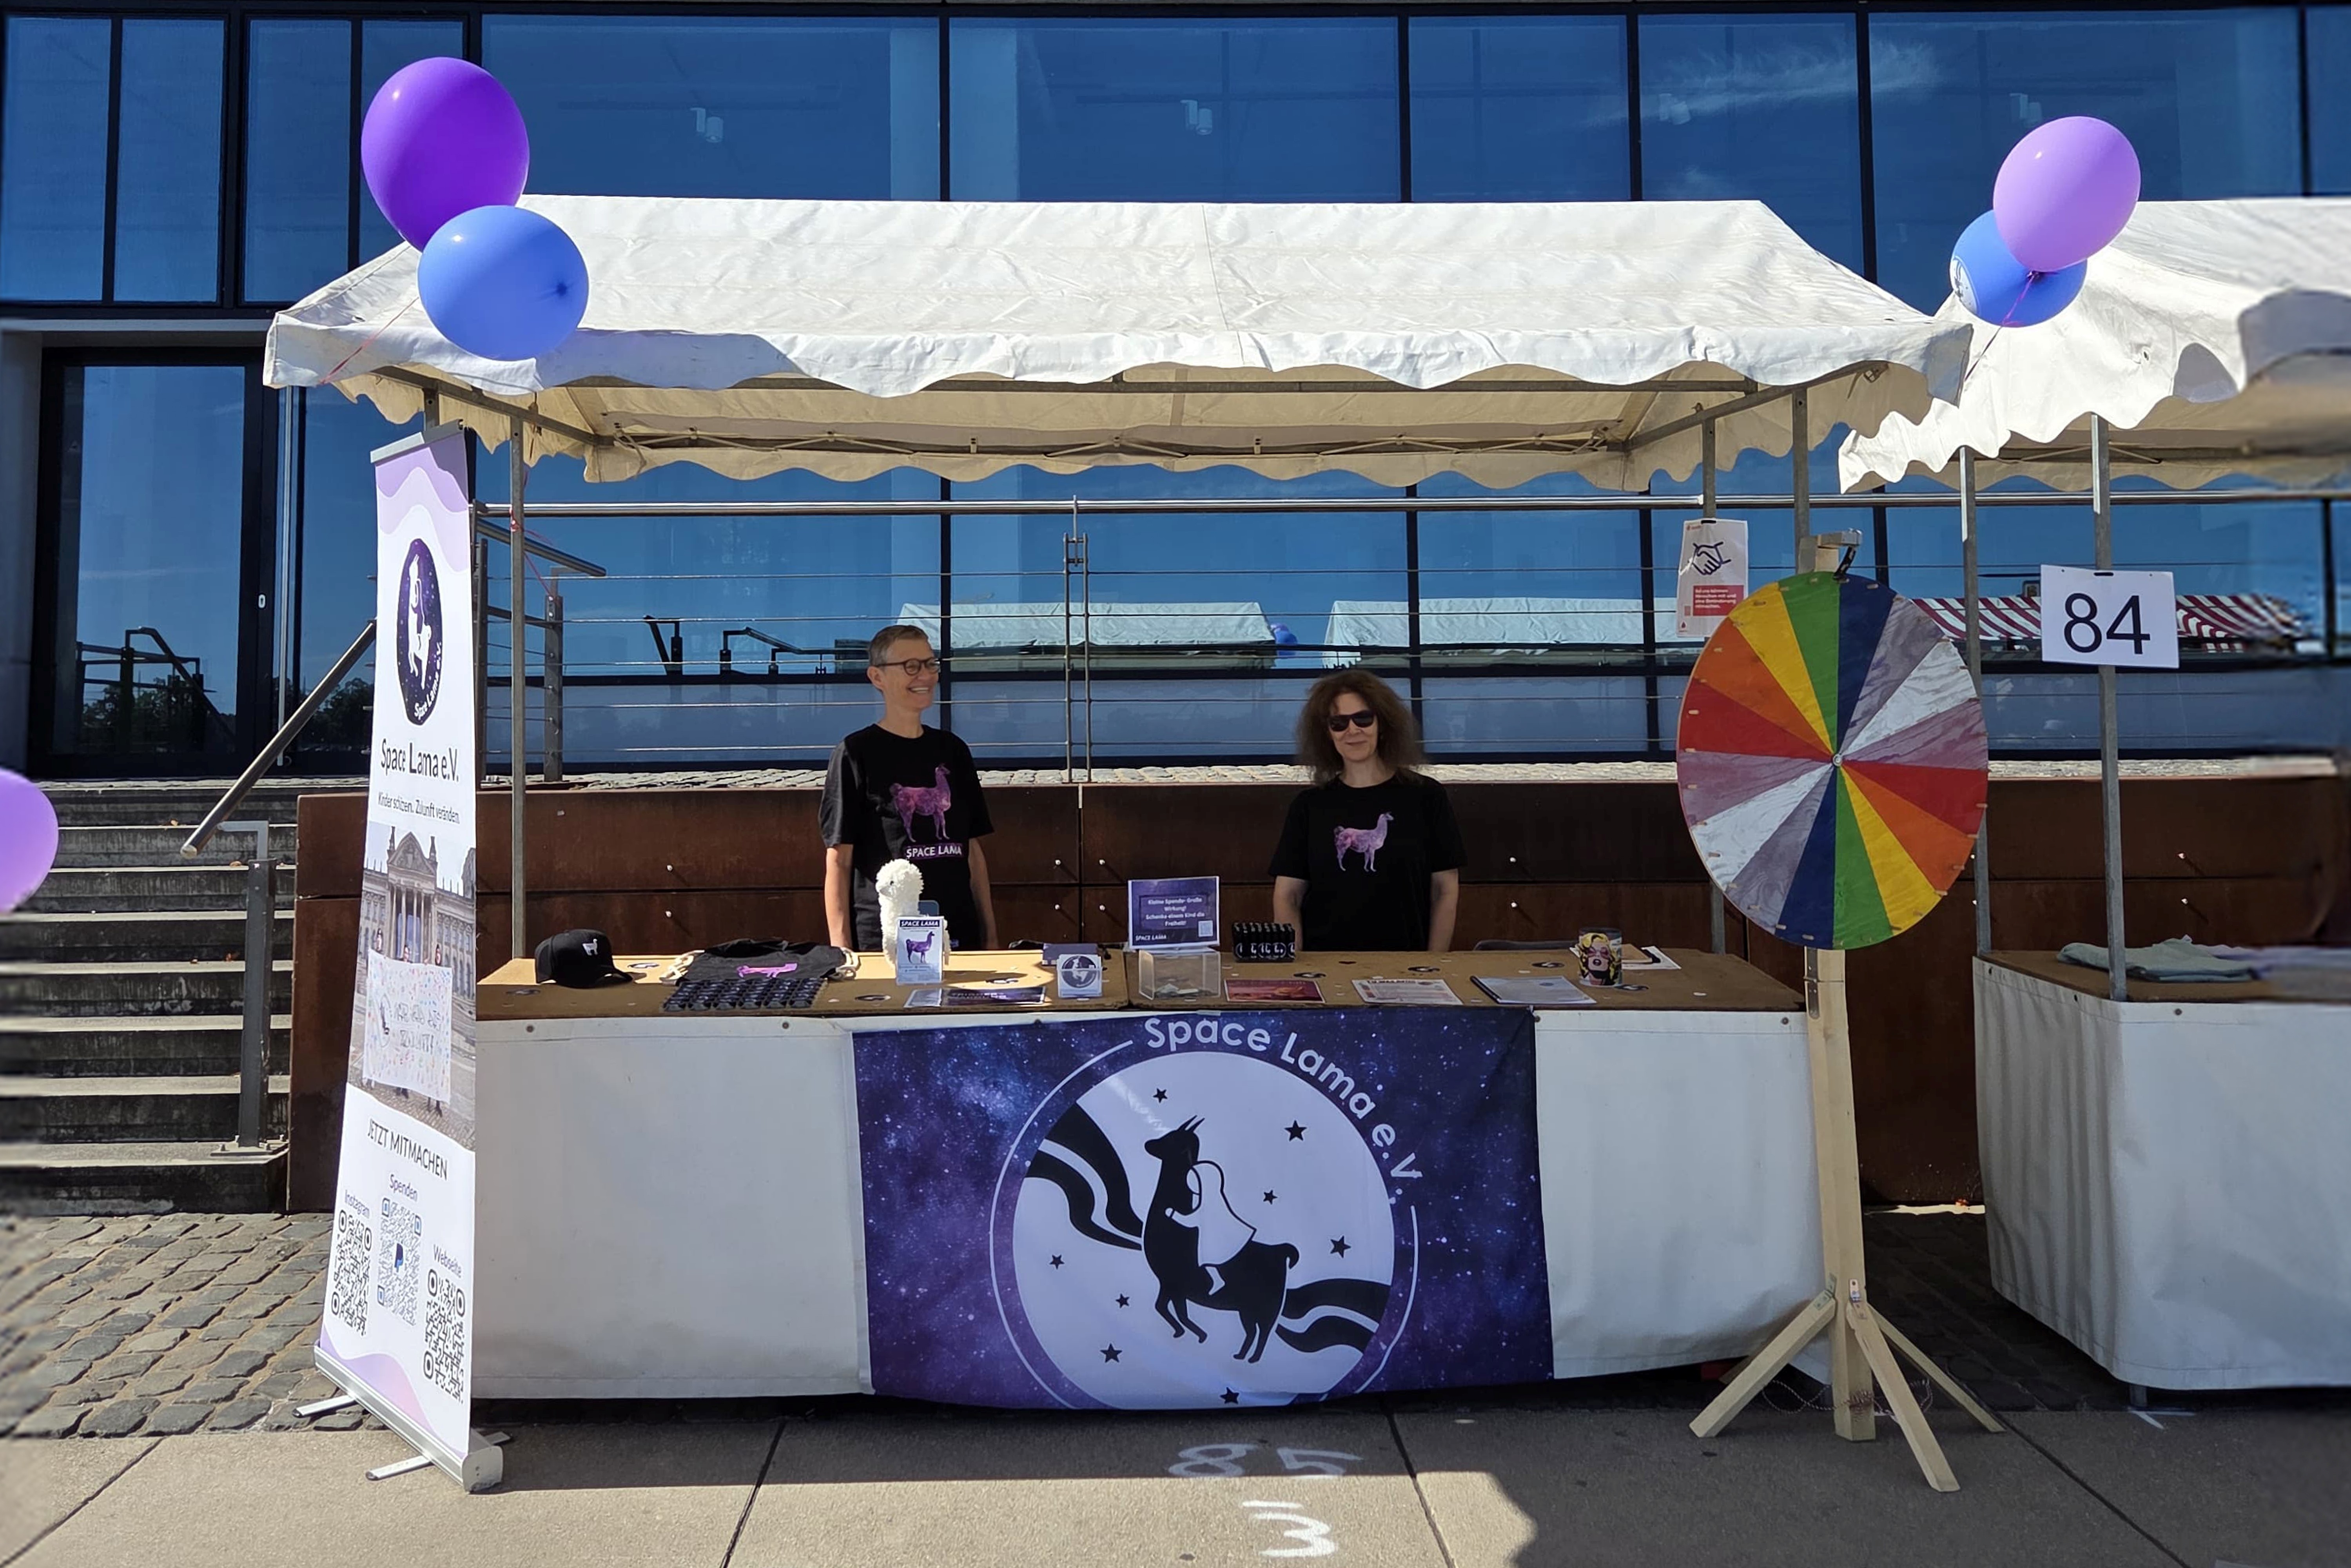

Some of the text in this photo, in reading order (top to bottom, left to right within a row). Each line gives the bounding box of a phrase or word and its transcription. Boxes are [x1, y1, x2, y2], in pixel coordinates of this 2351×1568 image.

[2064, 592, 2151, 655] 84
[381, 738, 459, 782] Space Lama e.V.
[415, 799, 435, 818] Zukunft
[906, 846, 962, 858] SPACE LAMA
[1144, 1018, 1423, 1195] Space Lama e.V.
[367, 1118, 448, 1181] JETZT MITMACHEN
[389, 1174, 418, 1202] Spenden
[1168, 1443, 1363, 1479] 85
